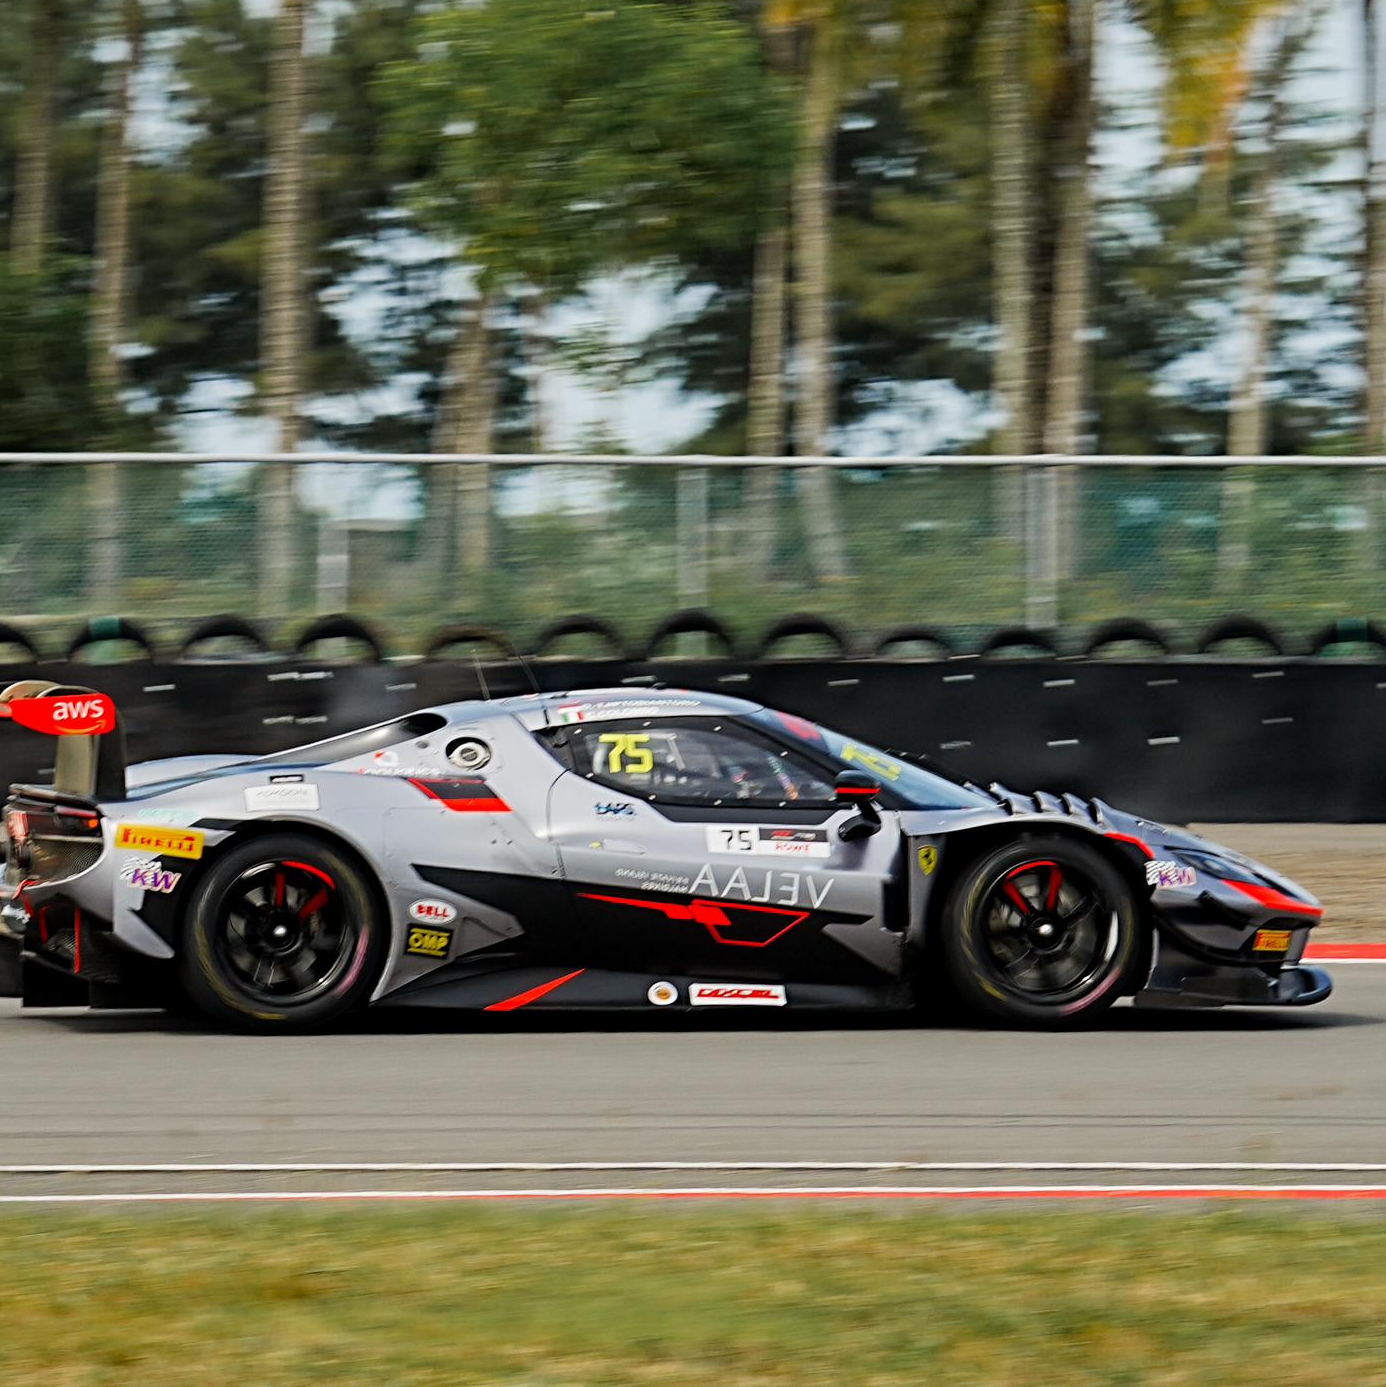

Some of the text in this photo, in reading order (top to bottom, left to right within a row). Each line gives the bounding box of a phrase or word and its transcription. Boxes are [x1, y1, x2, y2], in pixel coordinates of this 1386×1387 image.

[53, 699, 104, 721] aws
[599, 733, 653, 773] 75
[123, 828, 196, 851] PIRELLI
[720, 830, 752, 850] 75
[131, 868, 181, 892] KW
[417, 904, 449, 917] BELL
[409, 932, 448, 950] OMP
